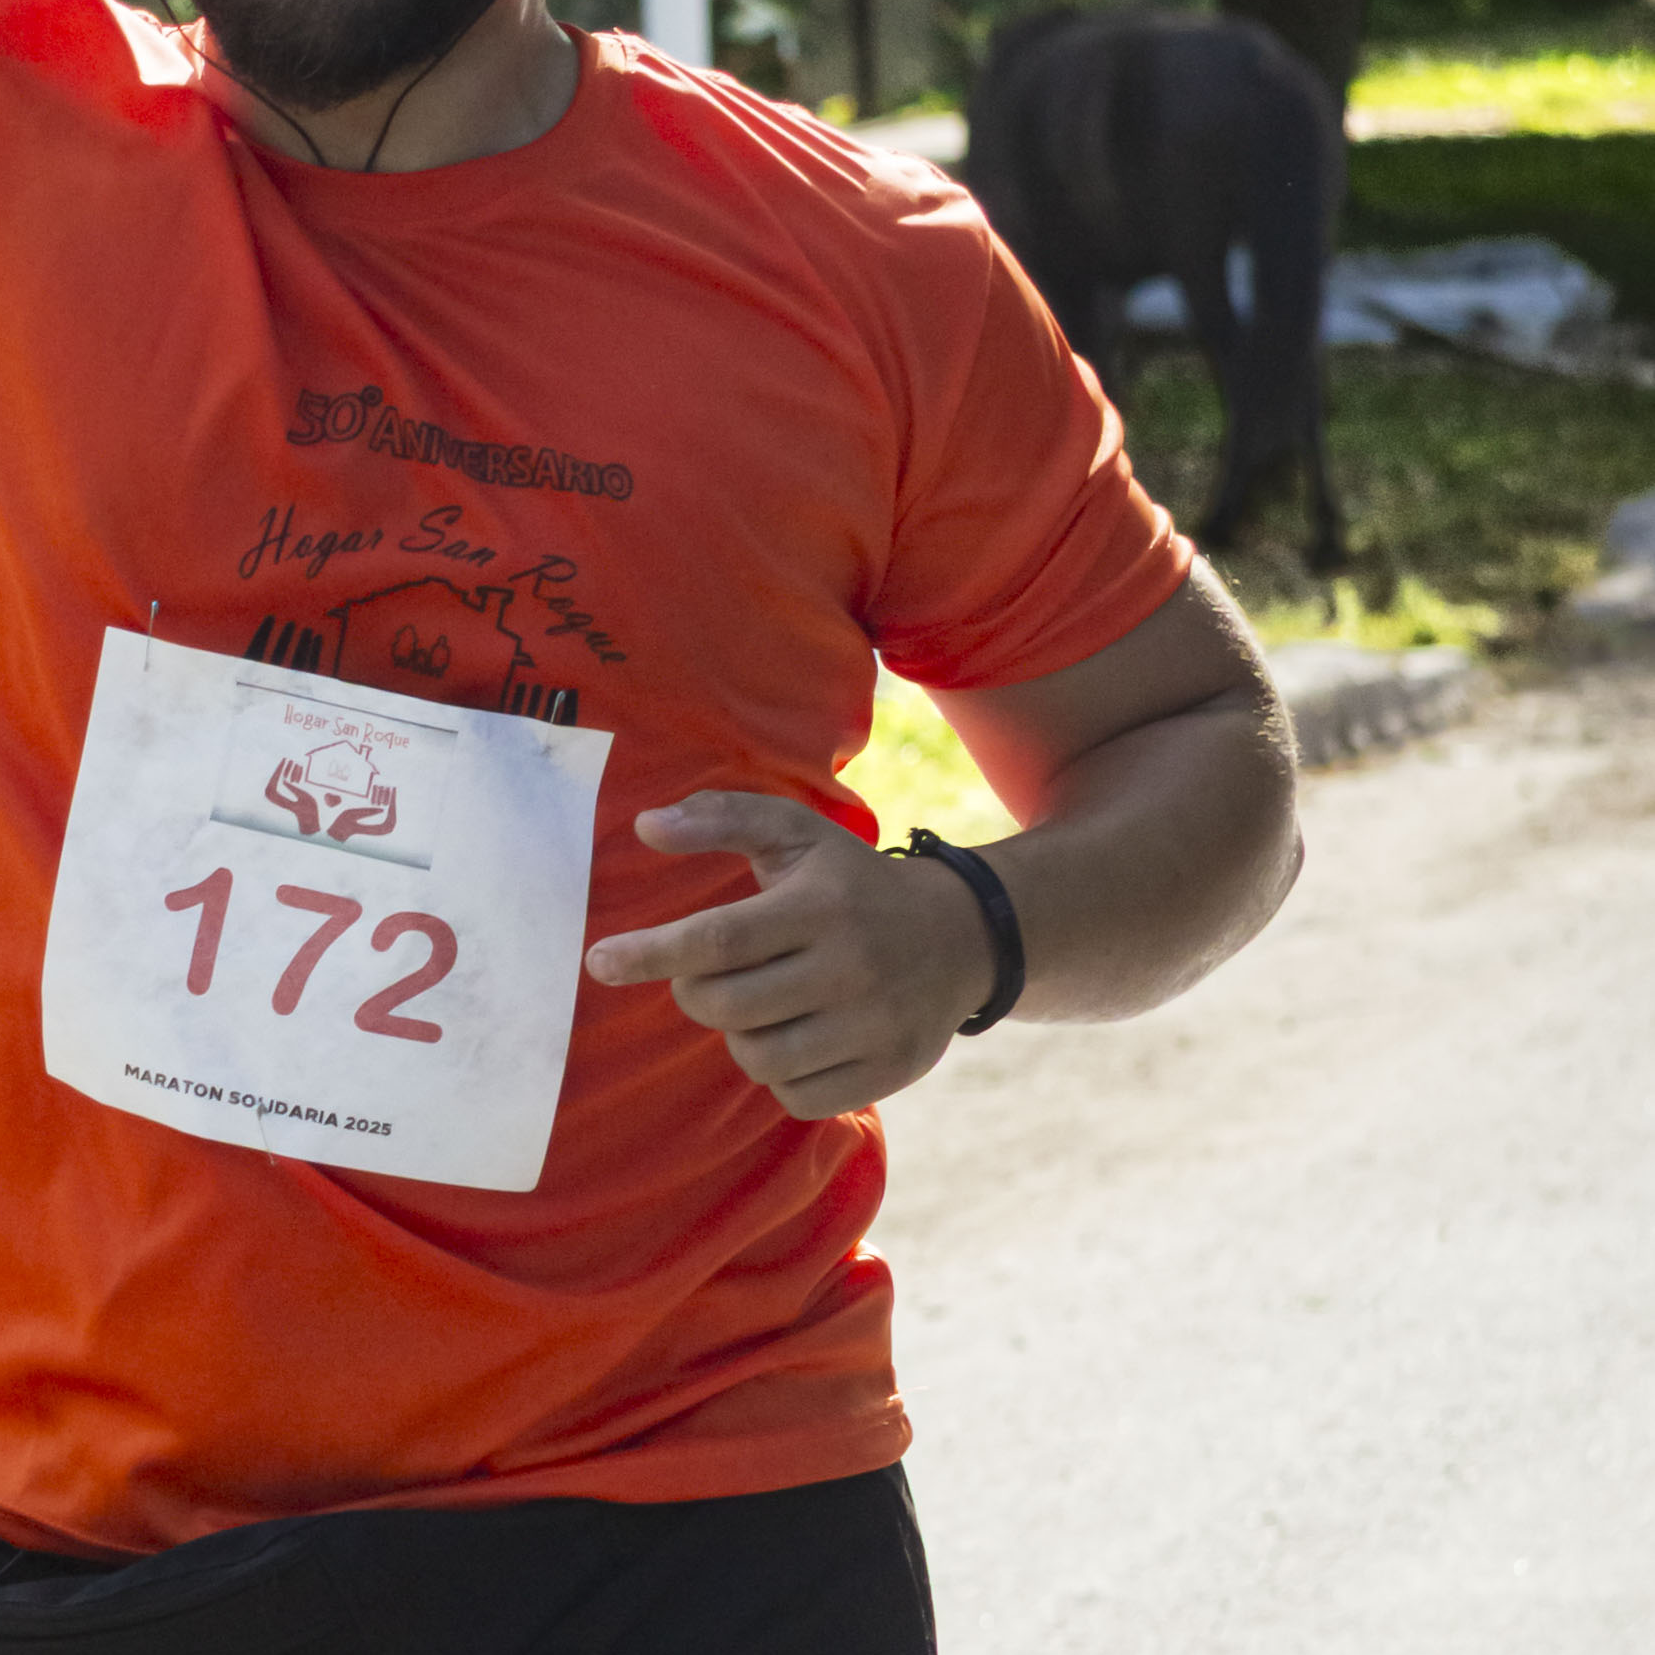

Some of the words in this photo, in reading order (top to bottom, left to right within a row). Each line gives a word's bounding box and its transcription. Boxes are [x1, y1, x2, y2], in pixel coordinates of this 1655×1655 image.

[368, 406, 633, 501] ANIVERSARIO
[239, 503, 384, 580] Hogar
[399, 505, 497, 568] San
[508, 554, 628, 664] Roque
[284, 704, 329, 731] Hogar
[332, 716, 360, 738] San
[362, 722, 410, 750] Roque
[164, 867, 458, 1044] 172
[124, 1063, 223, 1102] MARATON
[343, 1116, 392, 1137] 2025
